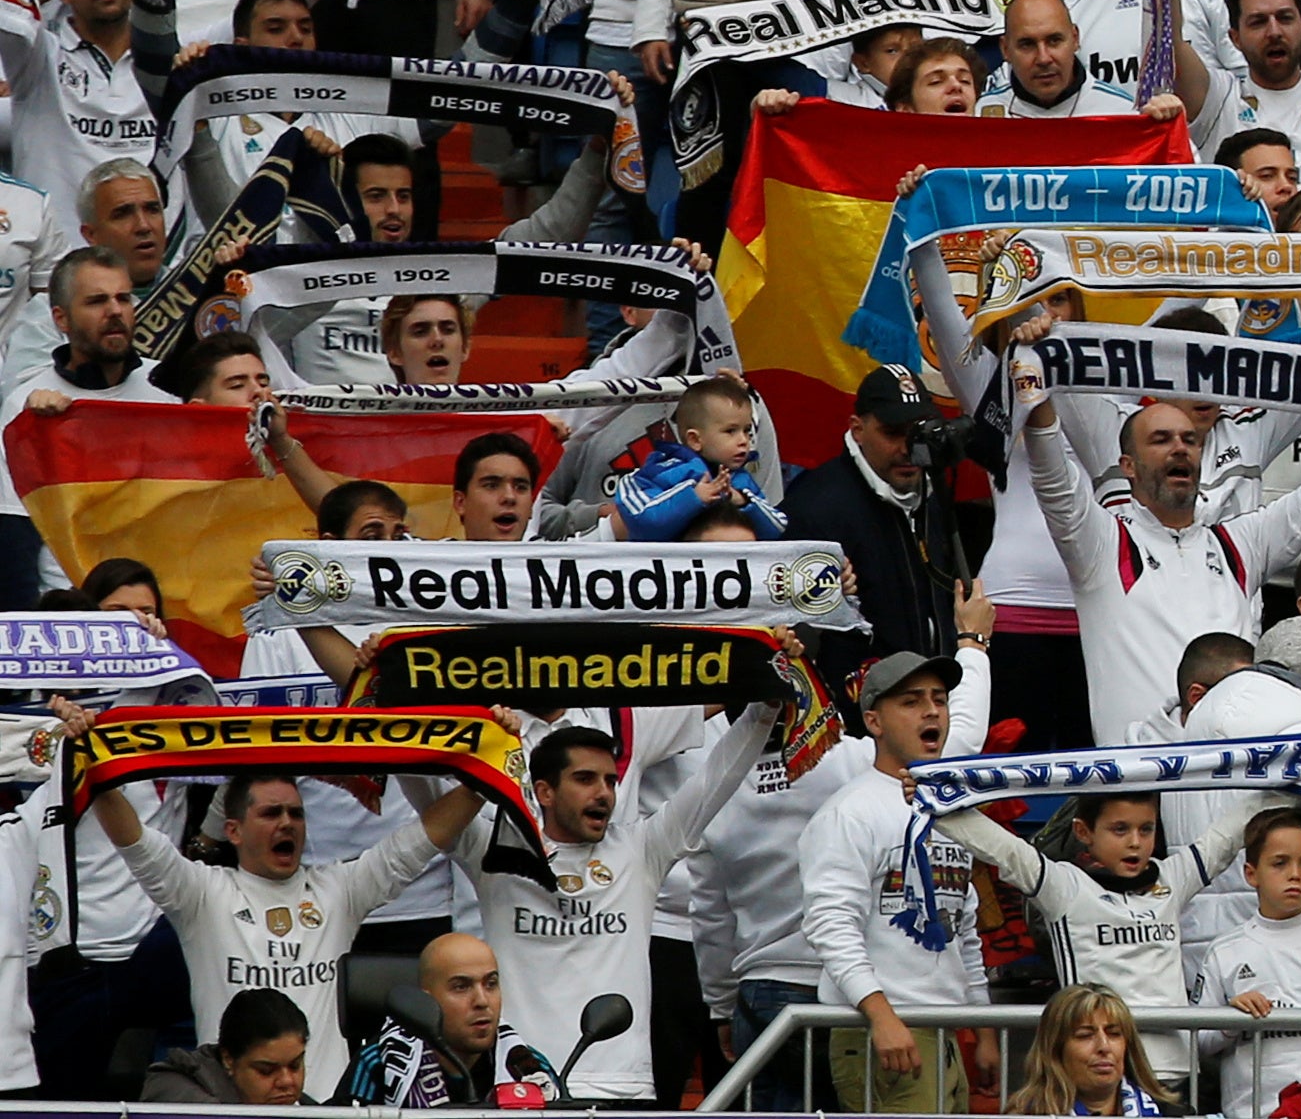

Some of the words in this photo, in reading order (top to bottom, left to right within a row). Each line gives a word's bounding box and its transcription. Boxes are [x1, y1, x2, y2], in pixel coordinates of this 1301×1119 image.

[680, 1, 803, 55] Real
[209, 85, 279, 106] DESDE
[292, 87, 347, 102] 1902
[430, 94, 502, 114] DESDE
[516, 105, 571, 125] 1902
[983, 173, 1069, 210] 2012
[1125, 174, 1209, 211] 1902
[303, 271, 378, 292] DESDE
[392, 267, 450, 283] 1902
[1042, 338, 1173, 390] REAL
[369, 556, 502, 610] Real
[527, 557, 751, 611] Madrid
[28, 661, 77, 674] DEL
[82, 656, 179, 674] MUNDO
[407, 642, 731, 690] Realmadrid
[180, 719, 252, 746] DE
[271, 716, 484, 753] EUROPA
[558, 897, 590, 917] Fly
[268, 940, 300, 961] Fly
[227, 956, 335, 988] Emirates
